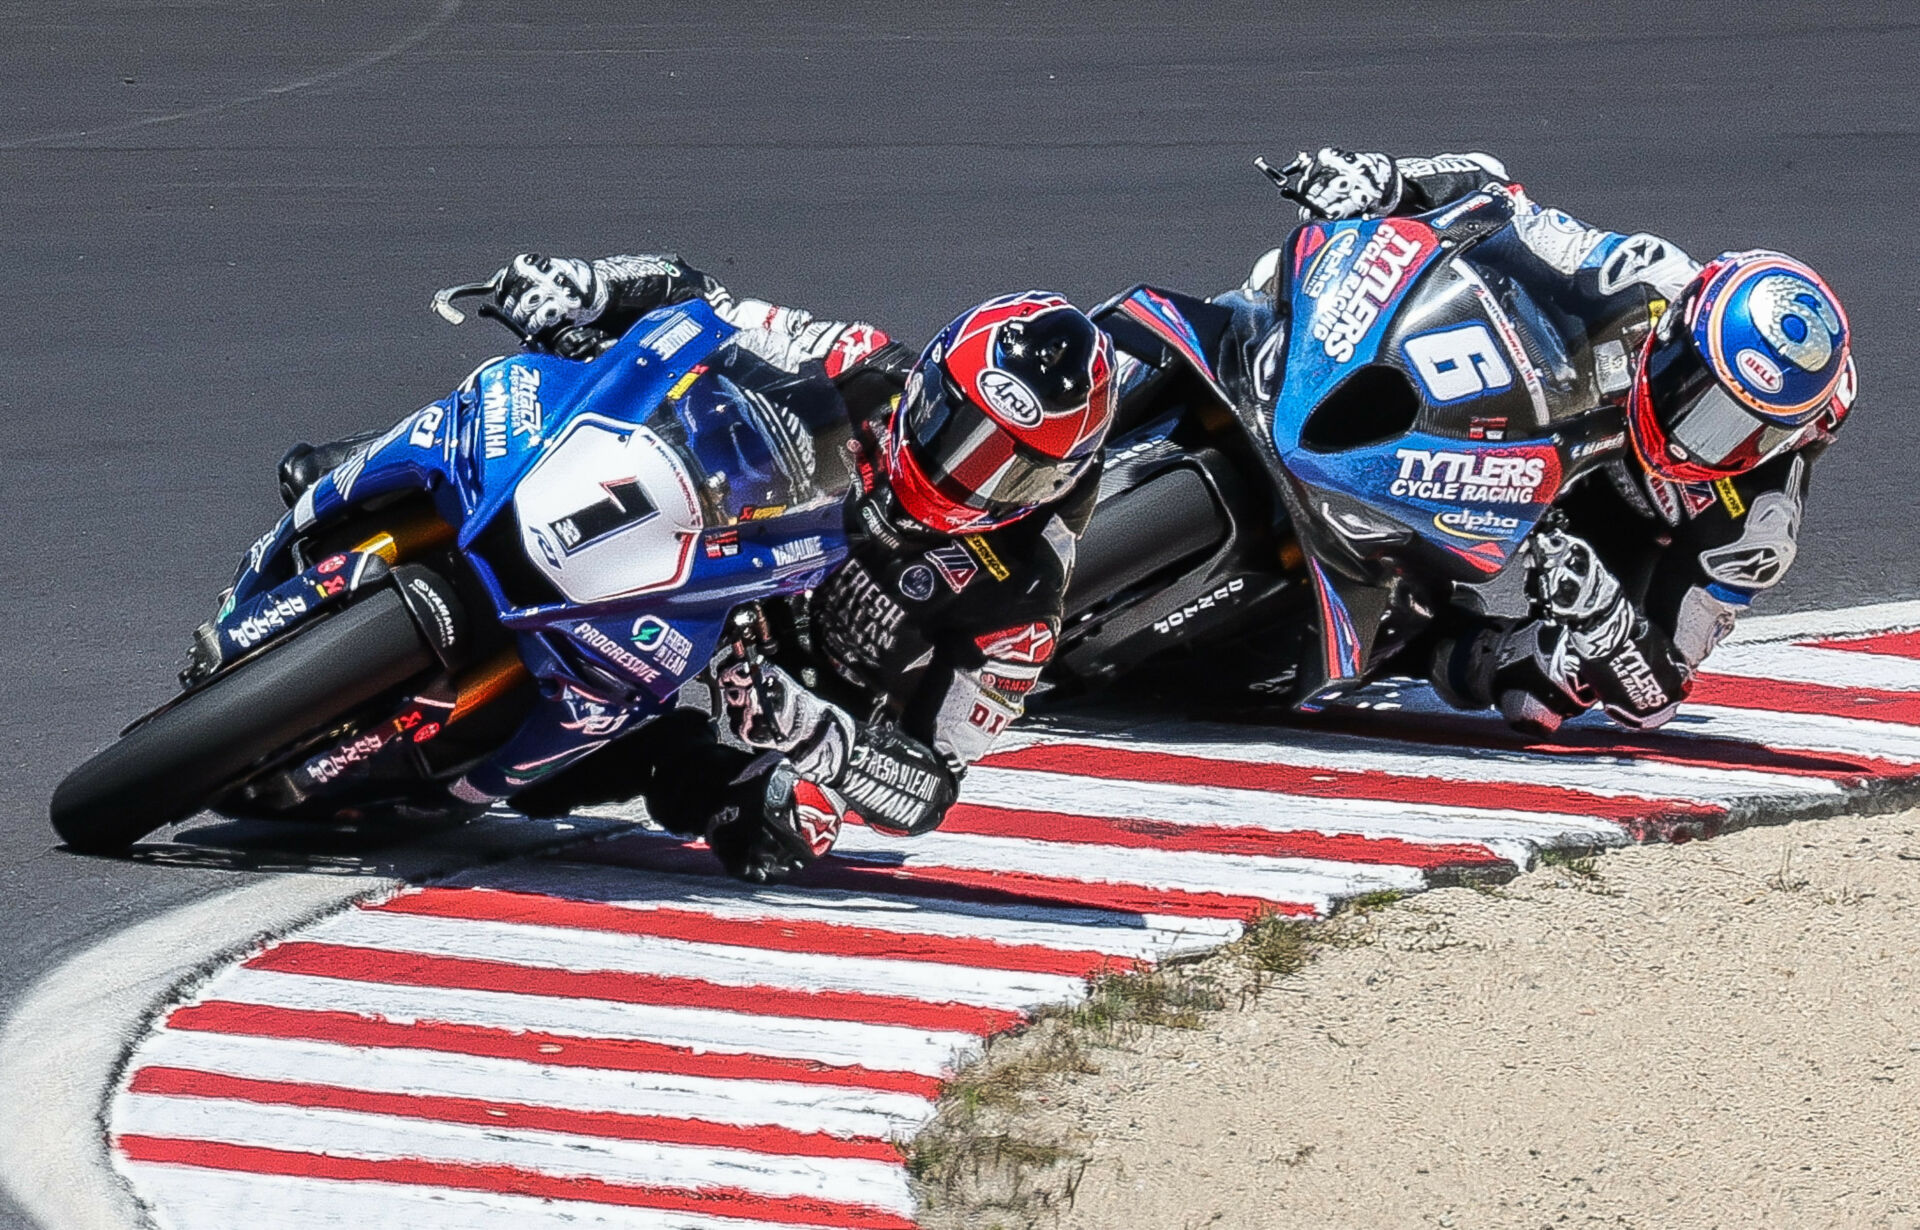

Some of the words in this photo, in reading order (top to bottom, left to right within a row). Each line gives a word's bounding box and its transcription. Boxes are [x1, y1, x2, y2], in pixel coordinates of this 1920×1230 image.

[1312, 234, 1358, 299] alpha
[1353, 224, 1387, 276] CYCLE
[1313, 273, 1366, 342] RACING
[1324, 233, 1422, 364] TYTLERS
[1403, 324, 1513, 402] 6
[1745, 357, 1776, 387] BELL
[982, 376, 1040, 418] Arai
[1390, 478, 1460, 501] CYCLE
[1460, 484, 1535, 505] RACING
[1396, 448, 1547, 488] TYTLERS
[548, 475, 661, 558] 1
[1442, 508, 1521, 532] alpha
[427, 588, 457, 646] YAMAHA
[842, 558, 906, 632] FRESH
[573, 621, 662, 684] PROGRESSIVE
[662, 651, 689, 677] LEAN
[665, 627, 694, 659] FRESH
[860, 748, 900, 786] FRESH
[906, 769, 941, 803] LEAN
[848, 779, 926, 828] YAMAHA
